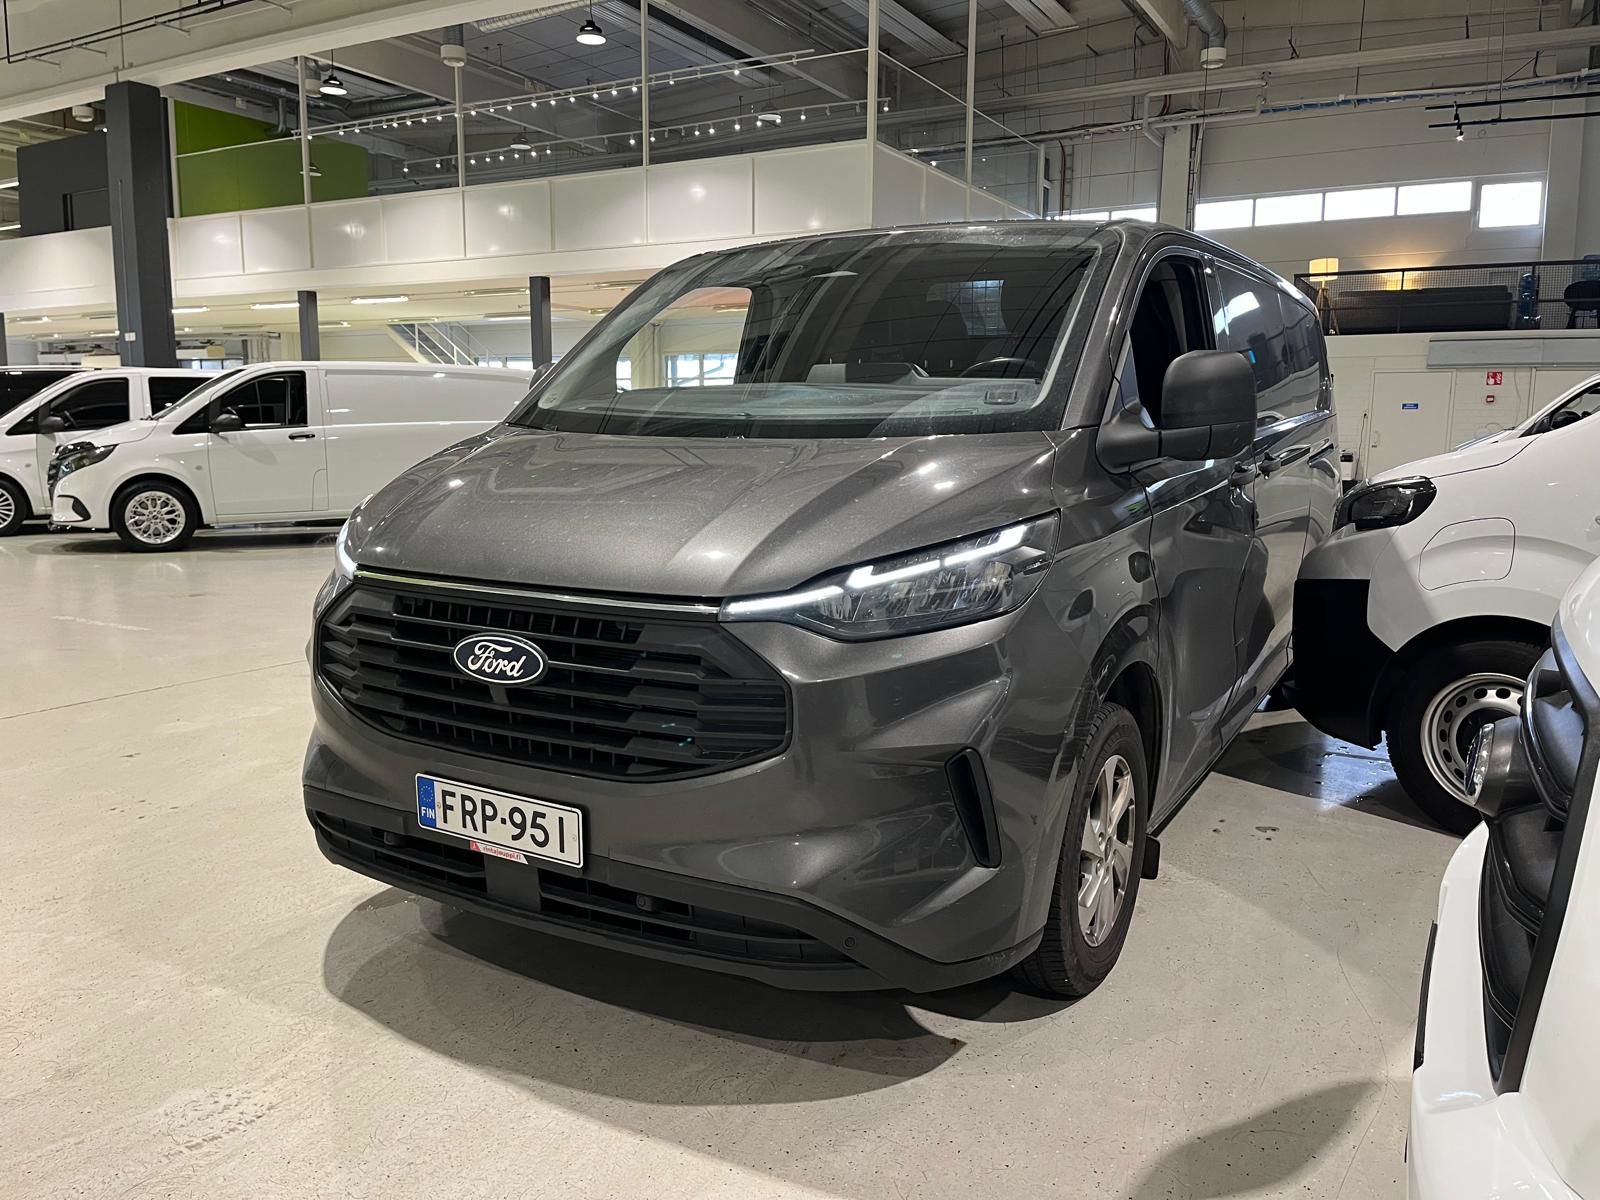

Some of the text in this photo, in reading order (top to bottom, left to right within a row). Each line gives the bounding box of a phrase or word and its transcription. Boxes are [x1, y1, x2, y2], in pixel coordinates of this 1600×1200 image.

[467, 641, 527, 677] Ford
[421, 806, 436, 820] FIN
[441, 789, 565, 853] FRP-951
